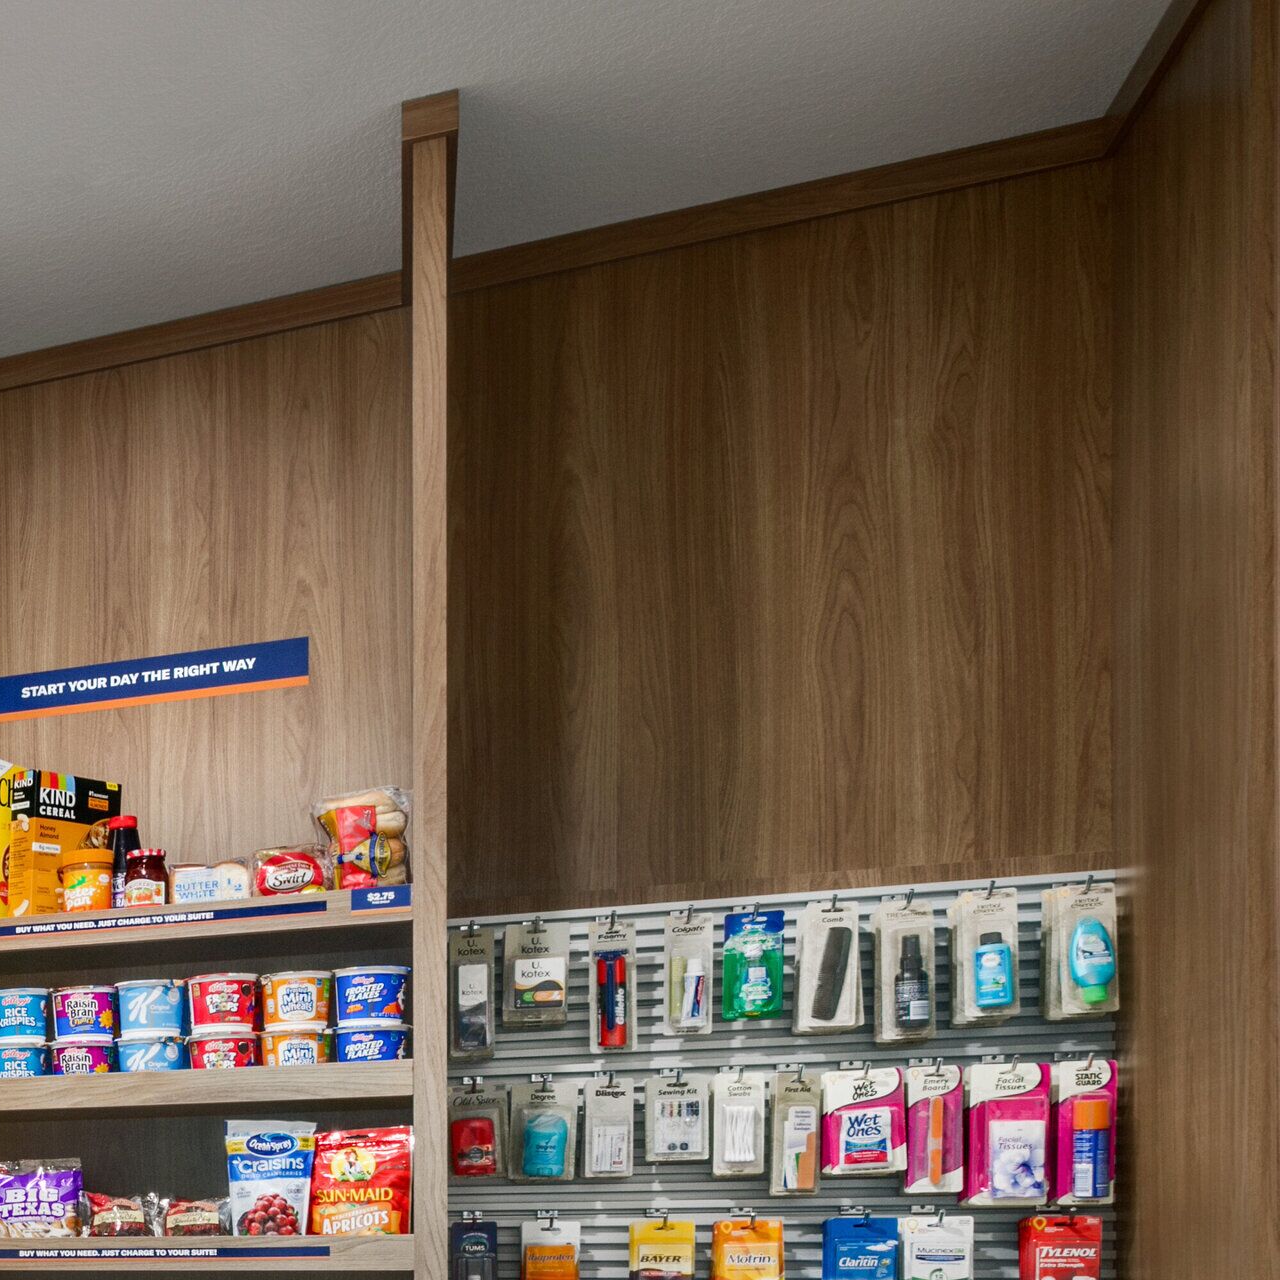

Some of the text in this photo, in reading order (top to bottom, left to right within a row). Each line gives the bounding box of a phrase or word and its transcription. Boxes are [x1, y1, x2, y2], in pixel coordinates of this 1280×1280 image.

[21, 657, 256, 699] START YOUR DAY THE RIGHT WAY
[40, 788, 76, 808] KIND
[40, 805, 76, 819] CEREAL
[272, 873, 306, 887] Swirl
[175, 880, 219, 892] BUTTER
[179, 890, 216, 899] WHITE
[367, 892, 395, 901] $2.75
[15, 926, 31, 934] BUY
[32, 924, 55, 932] WHAT
[56, 923, 72, 931] YOU
[73, 921, 96, 930] NEED.
[97, 919, 117, 928] JUST
[117, 917, 151, 926] CHARGE
[164, 914, 187, 922] YOUR
[188, 912, 214, 920] SUITE!
[672, 925, 706, 934] Colgate
[597, 933, 627, 941] Foamy
[521, 969, 550, 978] kotex
[345, 983, 384, 996] FROSTED
[283, 992, 312, 1004] Mini
[347, 992, 380, 1003] FLAKES
[66, 999, 97, 1009] Raisin
[615, 988, 625, 1025] Gillette
[4, 1008, 28, 1017] RICE
[70, 1008, 93, 1018] Bran
[345, 1040, 384, 1053] FROSTED
[61, 1052, 91, 1064] Raisin
[284, 1048, 312, 1060] Mini
[347, 1049, 379, 1060] FLAKES
[4, 1061, 27, 1070] RICE
[1075, 1072, 1102, 1080] STATIC
[658, 1087, 698, 1096] Sewing Kit
[531, 1093, 556, 1102] Degree
[848, 1113, 881, 1128] Wet
[847, 1126, 881, 1137] Ones
[998, 1142, 1033, 1150] Tissues
[239, 1157, 304, 1174] Craisins
[4, 1188, 59, 1203] BIG
[322, 1209, 389, 1235] APRICOTS
[156, 1249, 167, 1257] TO
[168, 1249, 190, 1257] YOUR
[191, 1249, 217, 1257] SUITE!
[465, 1244, 485, 1252] TUMS
[1039, 1247, 1096, 1258] TYLENOL
[640, 1254, 682, 1263] BAYER
[728, 1254, 771, 1264] Motrin
[839, 1255, 878, 1267] Claritin
